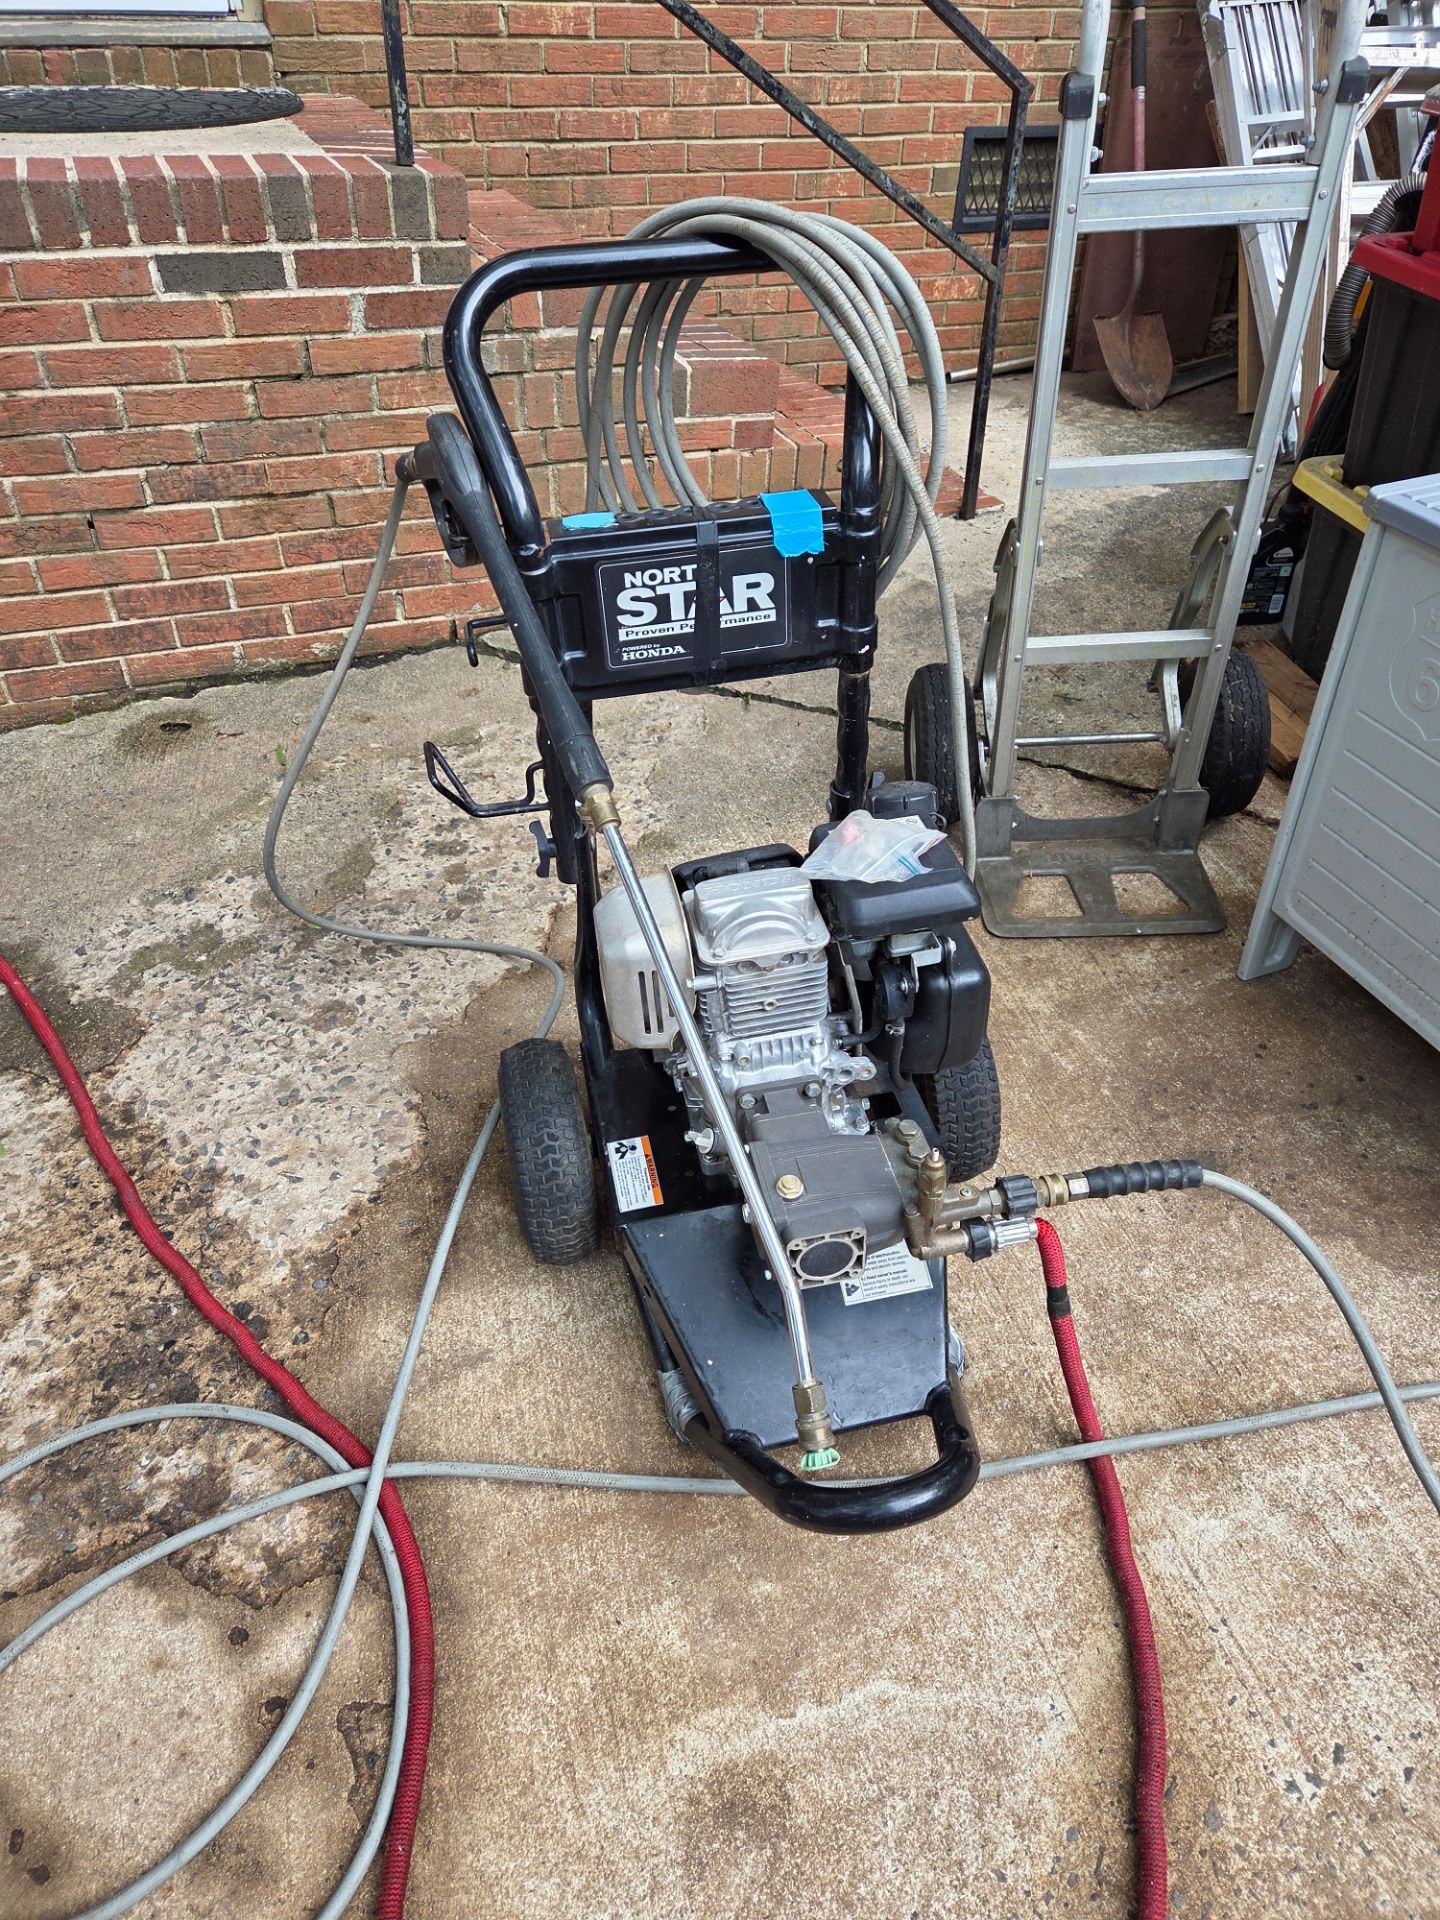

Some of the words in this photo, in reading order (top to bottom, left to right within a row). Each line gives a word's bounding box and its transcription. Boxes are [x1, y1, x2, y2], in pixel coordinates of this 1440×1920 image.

[624, 564, 697, 588] NORT
[625, 626, 675, 638] Proven
[622, 645, 687, 661] HONDA
[647, 1158, 659, 1188] WARNING
